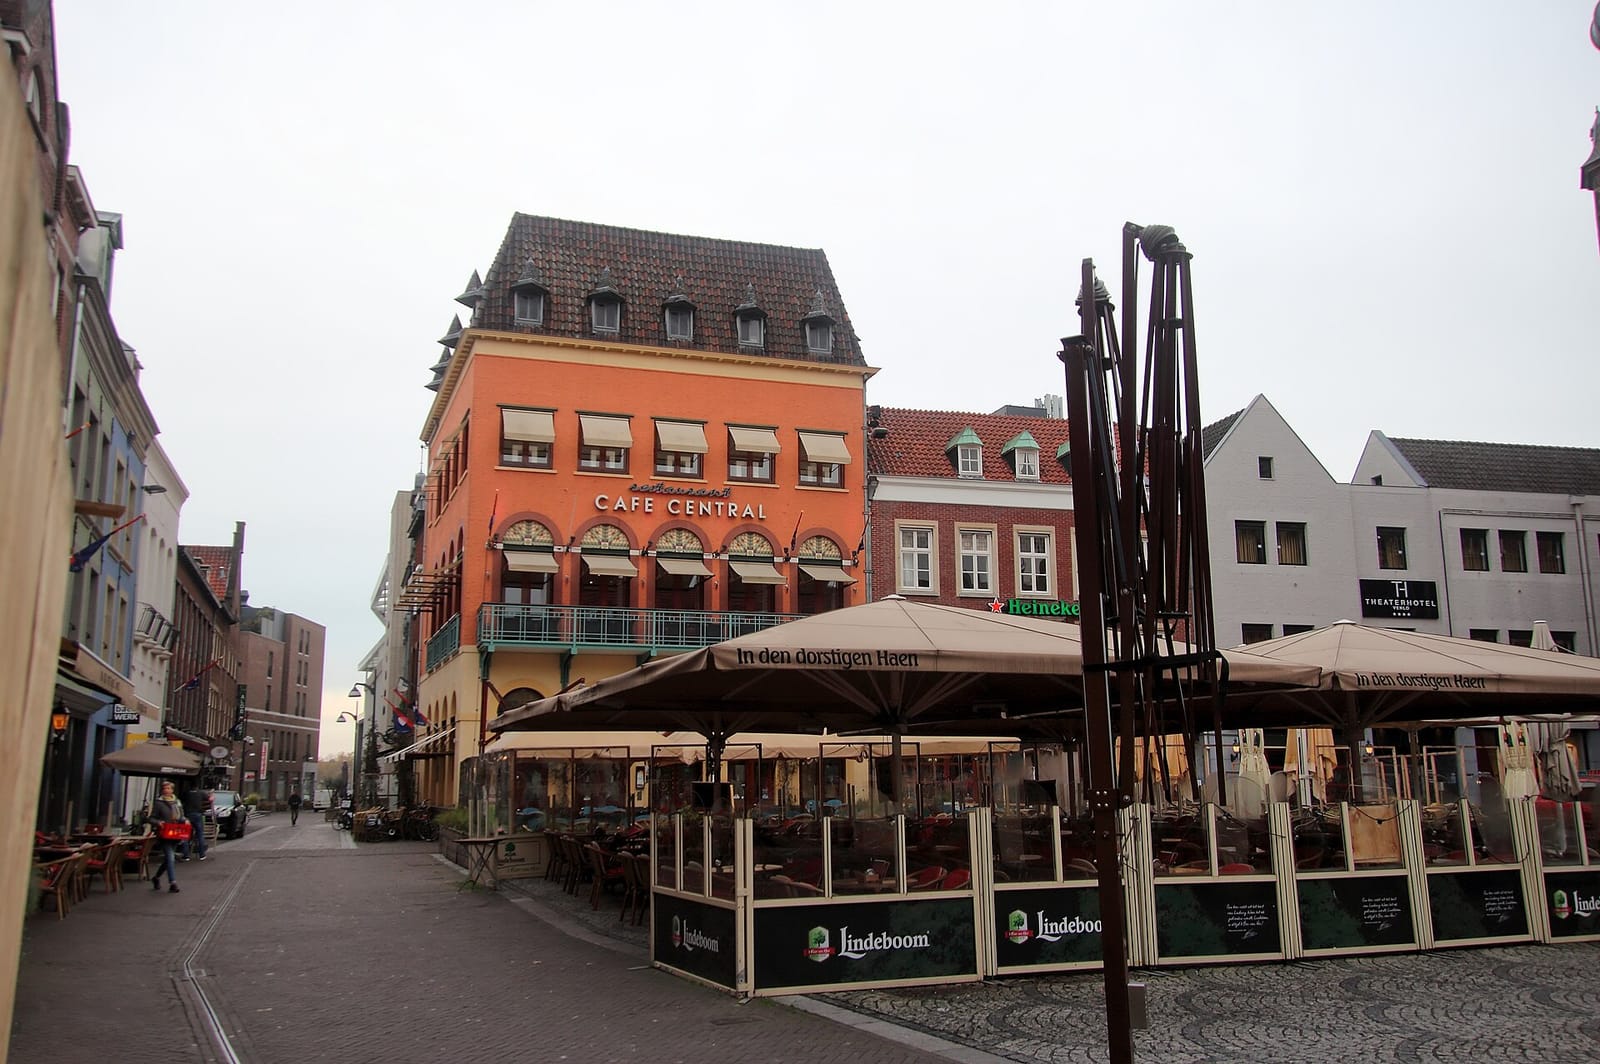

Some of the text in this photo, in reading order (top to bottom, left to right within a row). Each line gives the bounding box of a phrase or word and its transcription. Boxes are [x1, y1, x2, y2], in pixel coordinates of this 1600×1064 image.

[630, 483, 731, 498] restaurant
[595, 494, 767, 519] CAFE CENTRAL
[1008, 599, 1080, 616] Heineke
[1364, 598, 1437, 607] THEATERHOTEL
[737, 648, 919, 669] In den dorstigen Haen
[1355, 672, 1486, 691] In den dorstigen Haen
[1573, 890, 1600, 916] Linde
[683, 919, 719, 952] Lindeboom
[1036, 910, 1102, 941] Lindeboo
[838, 926, 930, 959] Lindeboom
